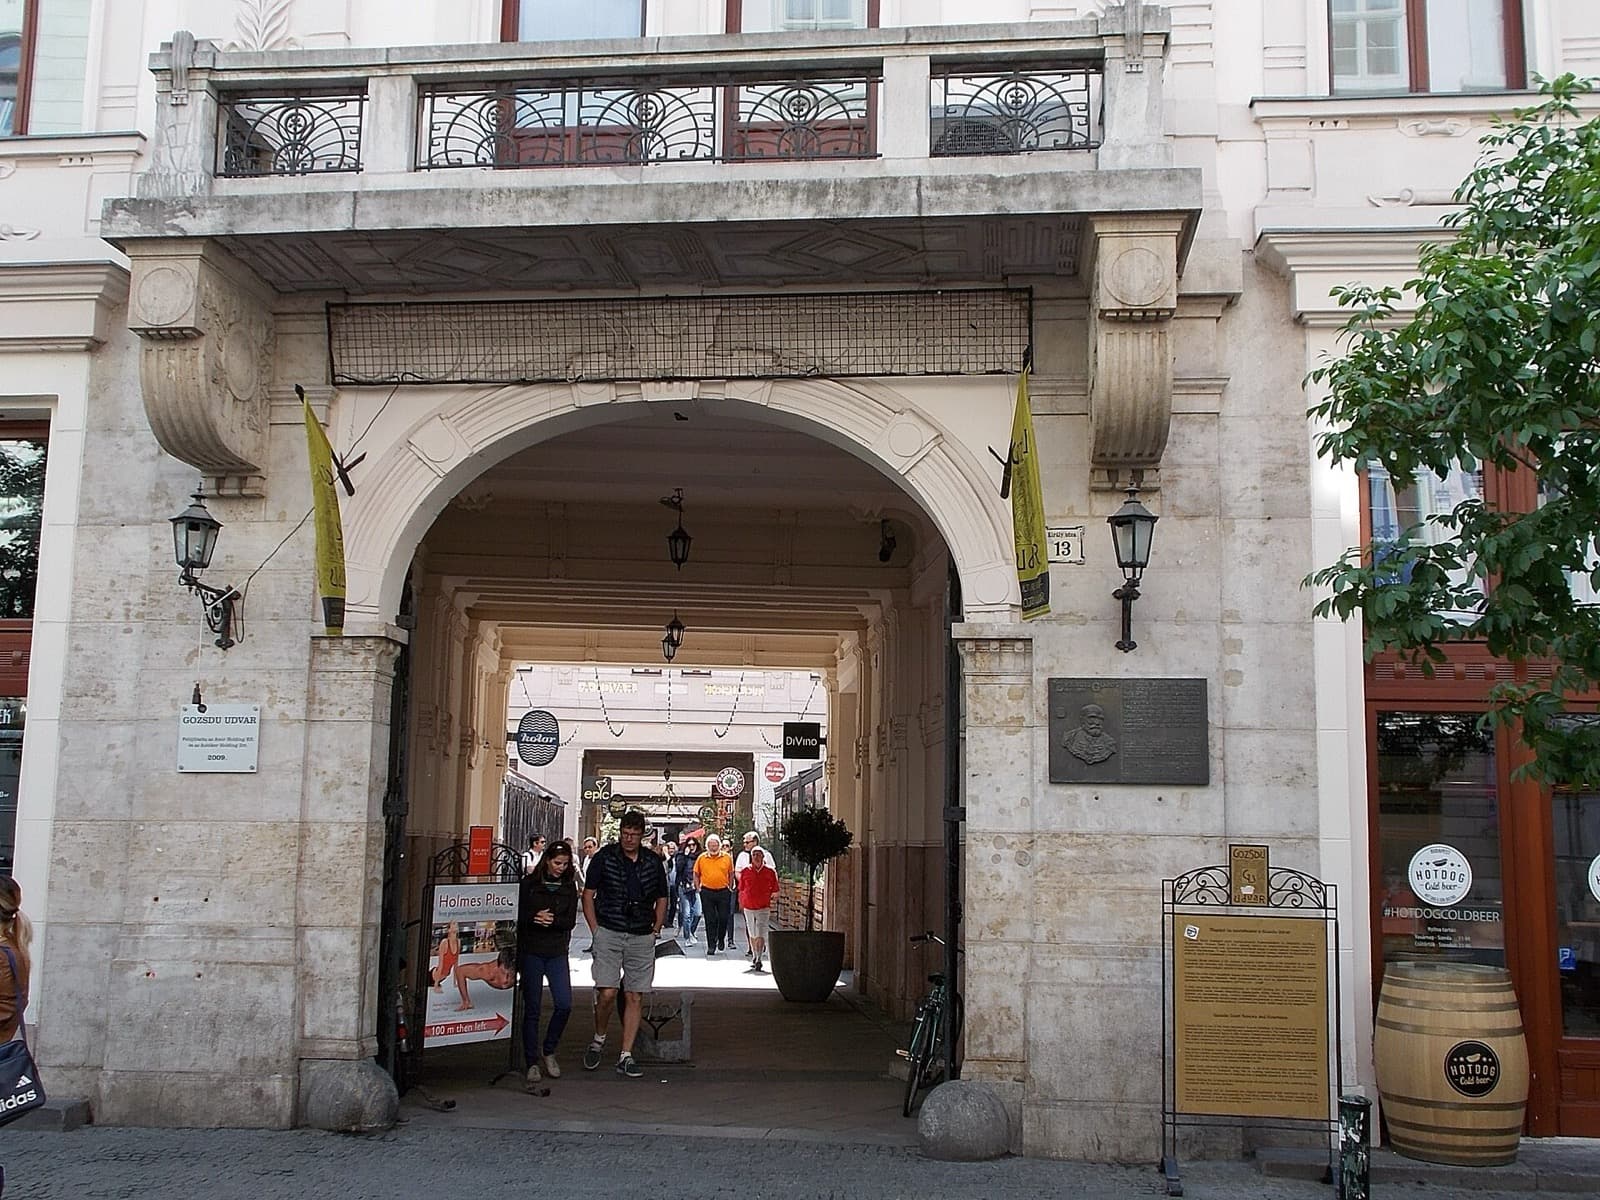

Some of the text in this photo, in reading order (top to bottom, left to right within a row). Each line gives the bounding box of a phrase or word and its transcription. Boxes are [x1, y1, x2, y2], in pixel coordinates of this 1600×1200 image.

[1054, 541, 1071, 556] 13
[182, 716, 257, 724] GOZSDU UDVAR
[583, 789, 611, 803] epic
[1415, 869, 1465, 883] HOTDOG
[439, 894, 482, 908] Holmes
[1384, 907, 1500, 922] #HOTDOGCOLDBEER
[431, 1025, 446, 1036] 100
[446, 1026, 456, 1034] m
[456, 1023, 474, 1033] then
[1450, 1064, 1496, 1077] HOTDOG
[1460, 1076, 1475, 1085] Cold
[0, 1089, 37, 1112] idas
